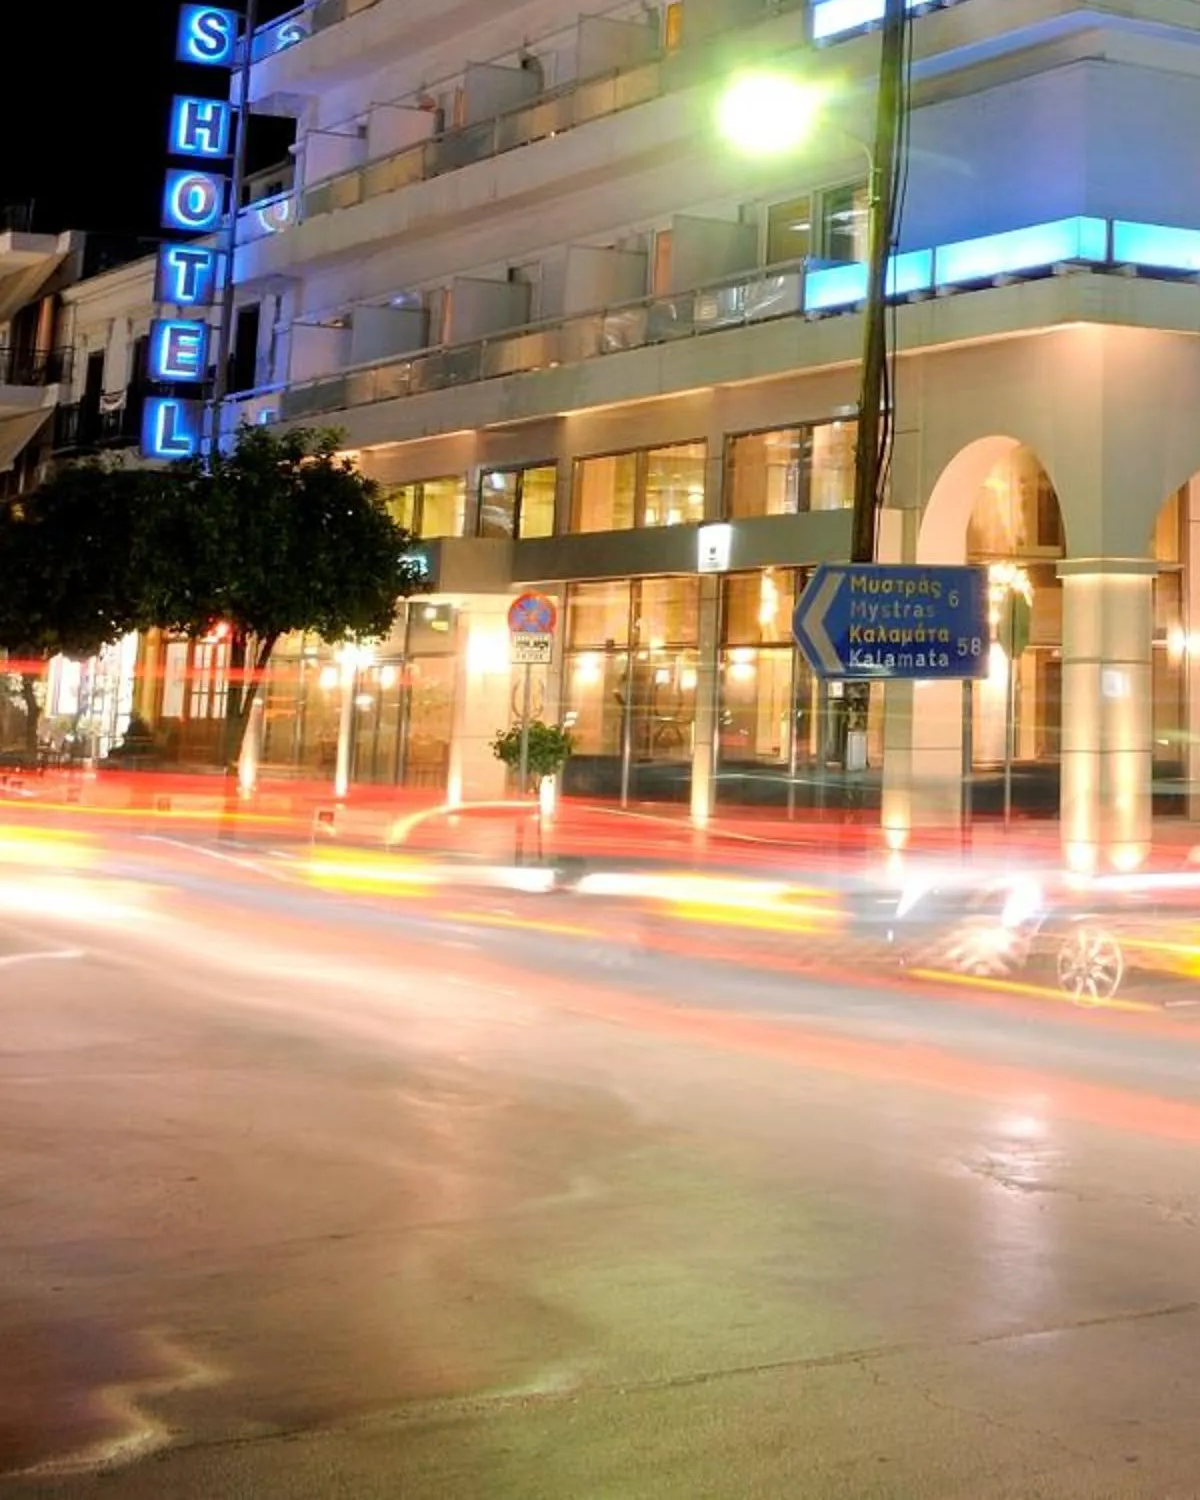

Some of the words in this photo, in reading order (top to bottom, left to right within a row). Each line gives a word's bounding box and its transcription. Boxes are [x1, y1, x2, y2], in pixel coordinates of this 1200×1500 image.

[153, 99, 223, 455] HOTEL
[850, 575, 941, 599] Μυστράς
[948, 589, 959, 608] 6
[850, 600, 935, 622] Mystras
[849, 622, 949, 647] Καλαμάτα
[957, 637, 981, 656] 58
[849, 648, 949, 668] Kalamata
